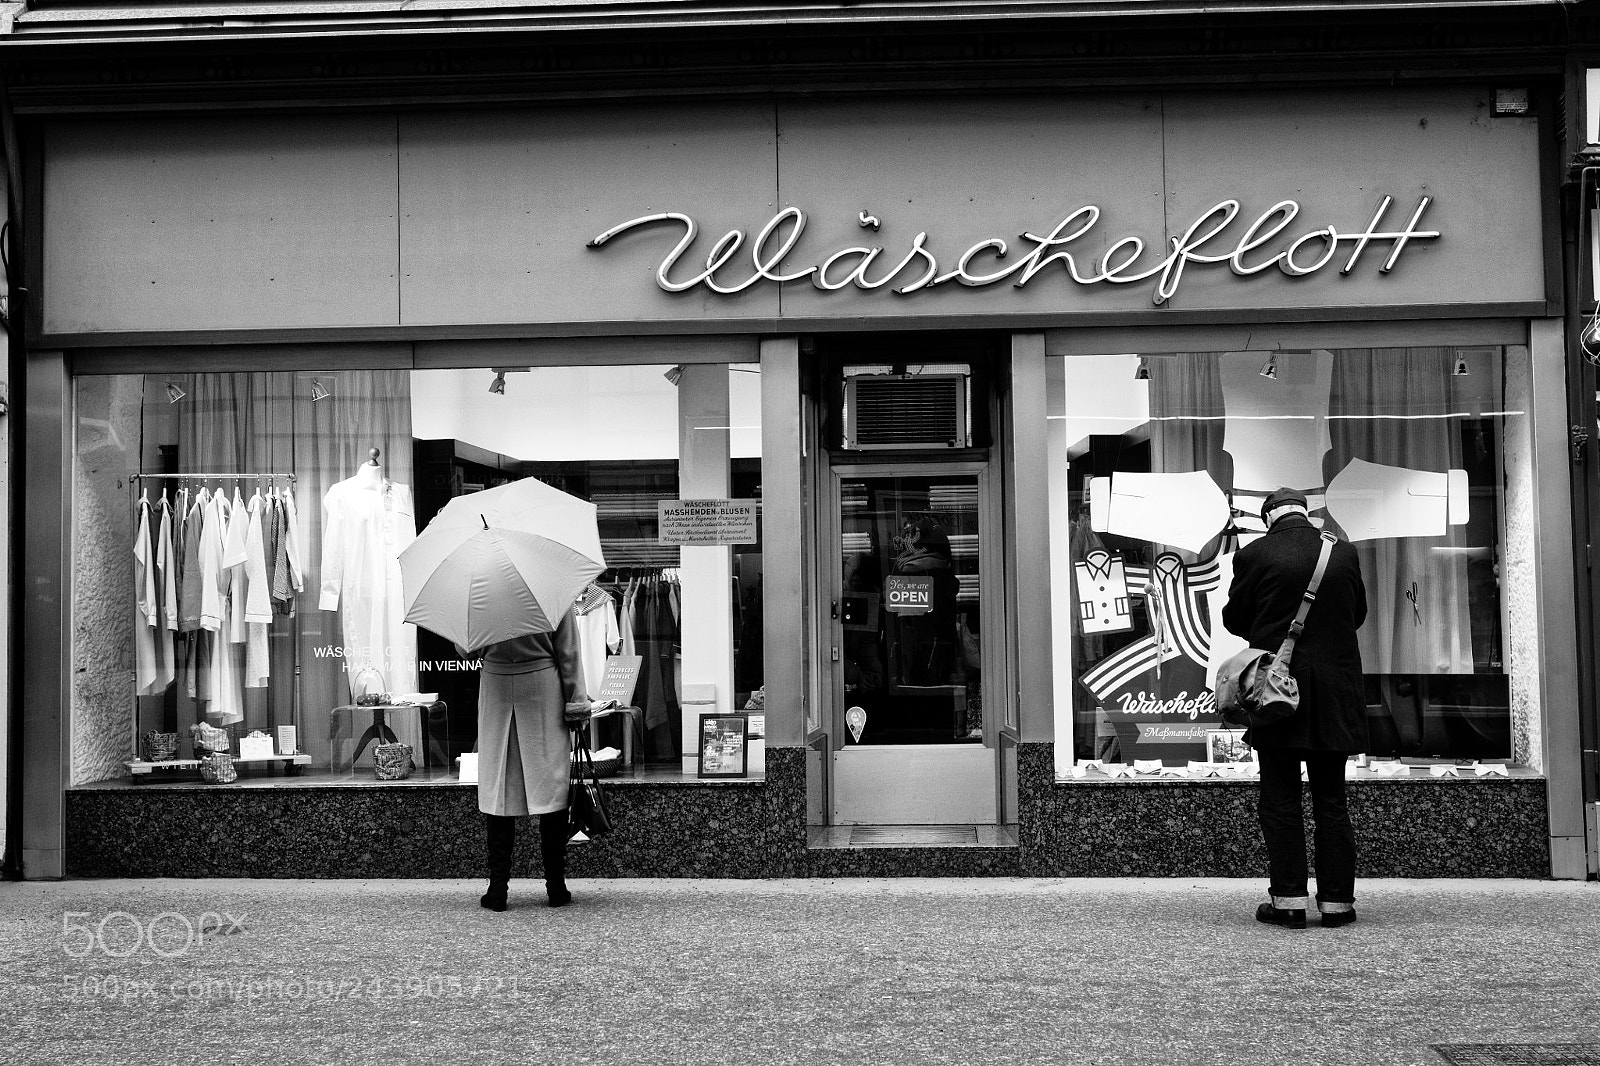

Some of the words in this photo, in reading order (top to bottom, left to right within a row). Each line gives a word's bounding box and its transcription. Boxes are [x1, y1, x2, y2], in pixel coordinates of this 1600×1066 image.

[720, 507, 750, 515] BLUSEN
[889, 590, 929, 602] OPEN
[419, 660, 432, 671] IN
[1116, 690, 1216, 720] Wäscheflo
